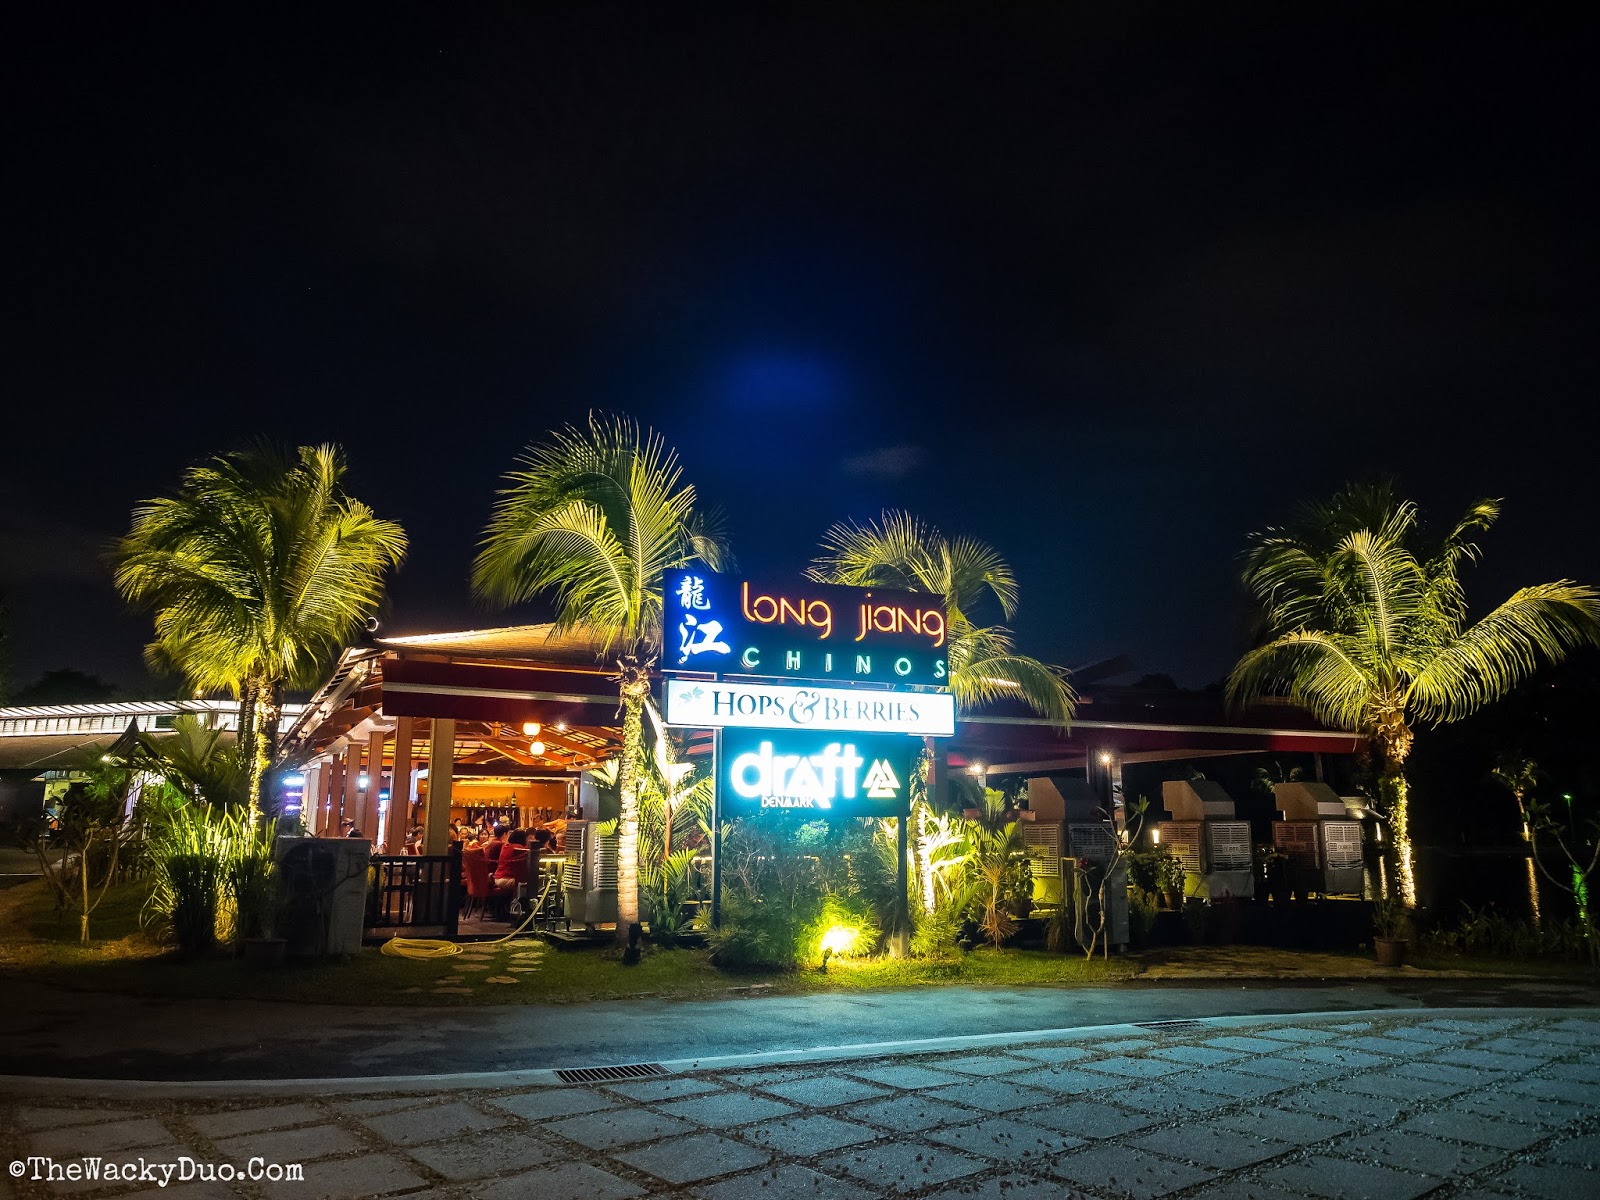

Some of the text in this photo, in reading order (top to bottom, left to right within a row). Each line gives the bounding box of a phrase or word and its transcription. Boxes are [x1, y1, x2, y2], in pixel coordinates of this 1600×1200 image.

[676, 576, 731, 664] 龍江
[741, 647, 946, 678] CHINOS
[825, 697, 919, 721] BERRIES
[731, 741, 864, 808] draft
[761, 796, 814, 808] DENMARK
